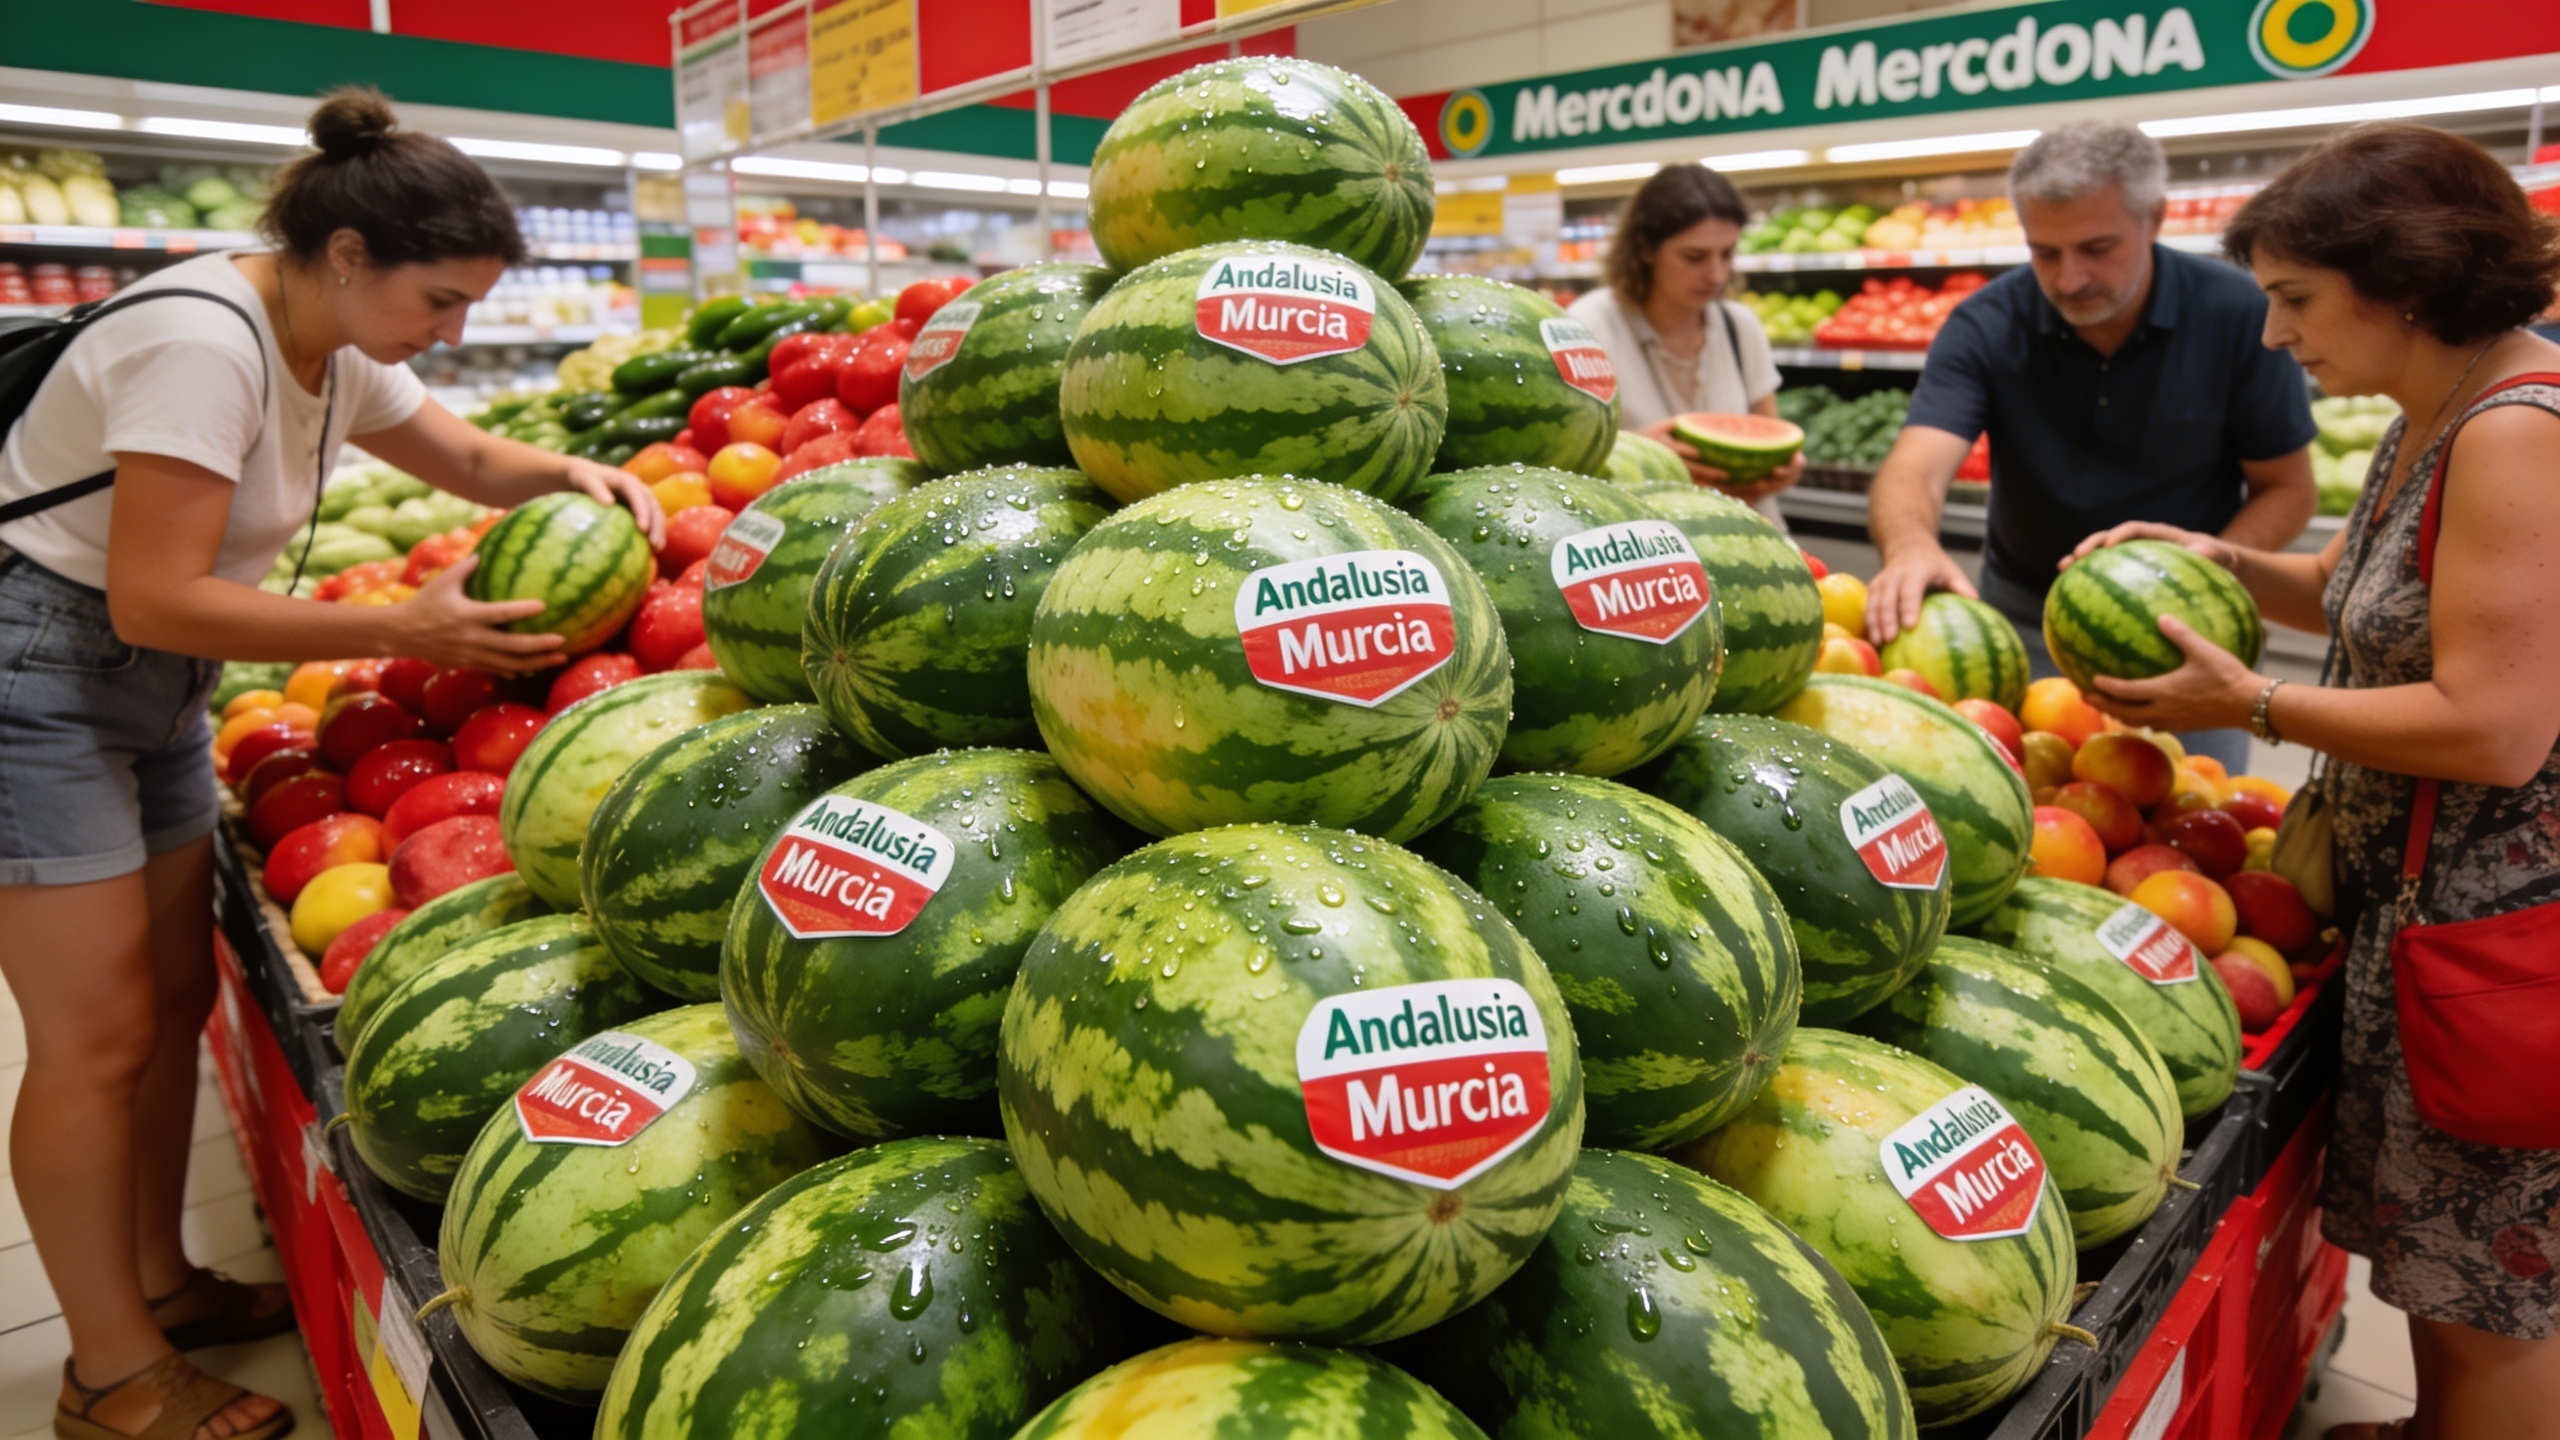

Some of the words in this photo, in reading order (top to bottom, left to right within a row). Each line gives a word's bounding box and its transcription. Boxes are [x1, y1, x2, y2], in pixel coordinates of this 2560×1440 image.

[1212, 262, 1358, 301] Andalusia
[1220, 297, 1348, 341] Murcia
[1566, 528, 1686, 576] Andalusia
[1255, 560, 1430, 616] Andalusia
[1589, 567, 1702, 622] Murcia
[1278, 611, 1436, 675] Murcia
[799, 799, 937, 874] Andalusia
[773, 842, 896, 922] Murcia
[1324, 993, 1529, 1061] Andalusia
[527, 1062, 632, 1134] Murcia
[1346, 1062, 1530, 1142] Murcia
[1934, 1138, 2036, 1225] Murcia
